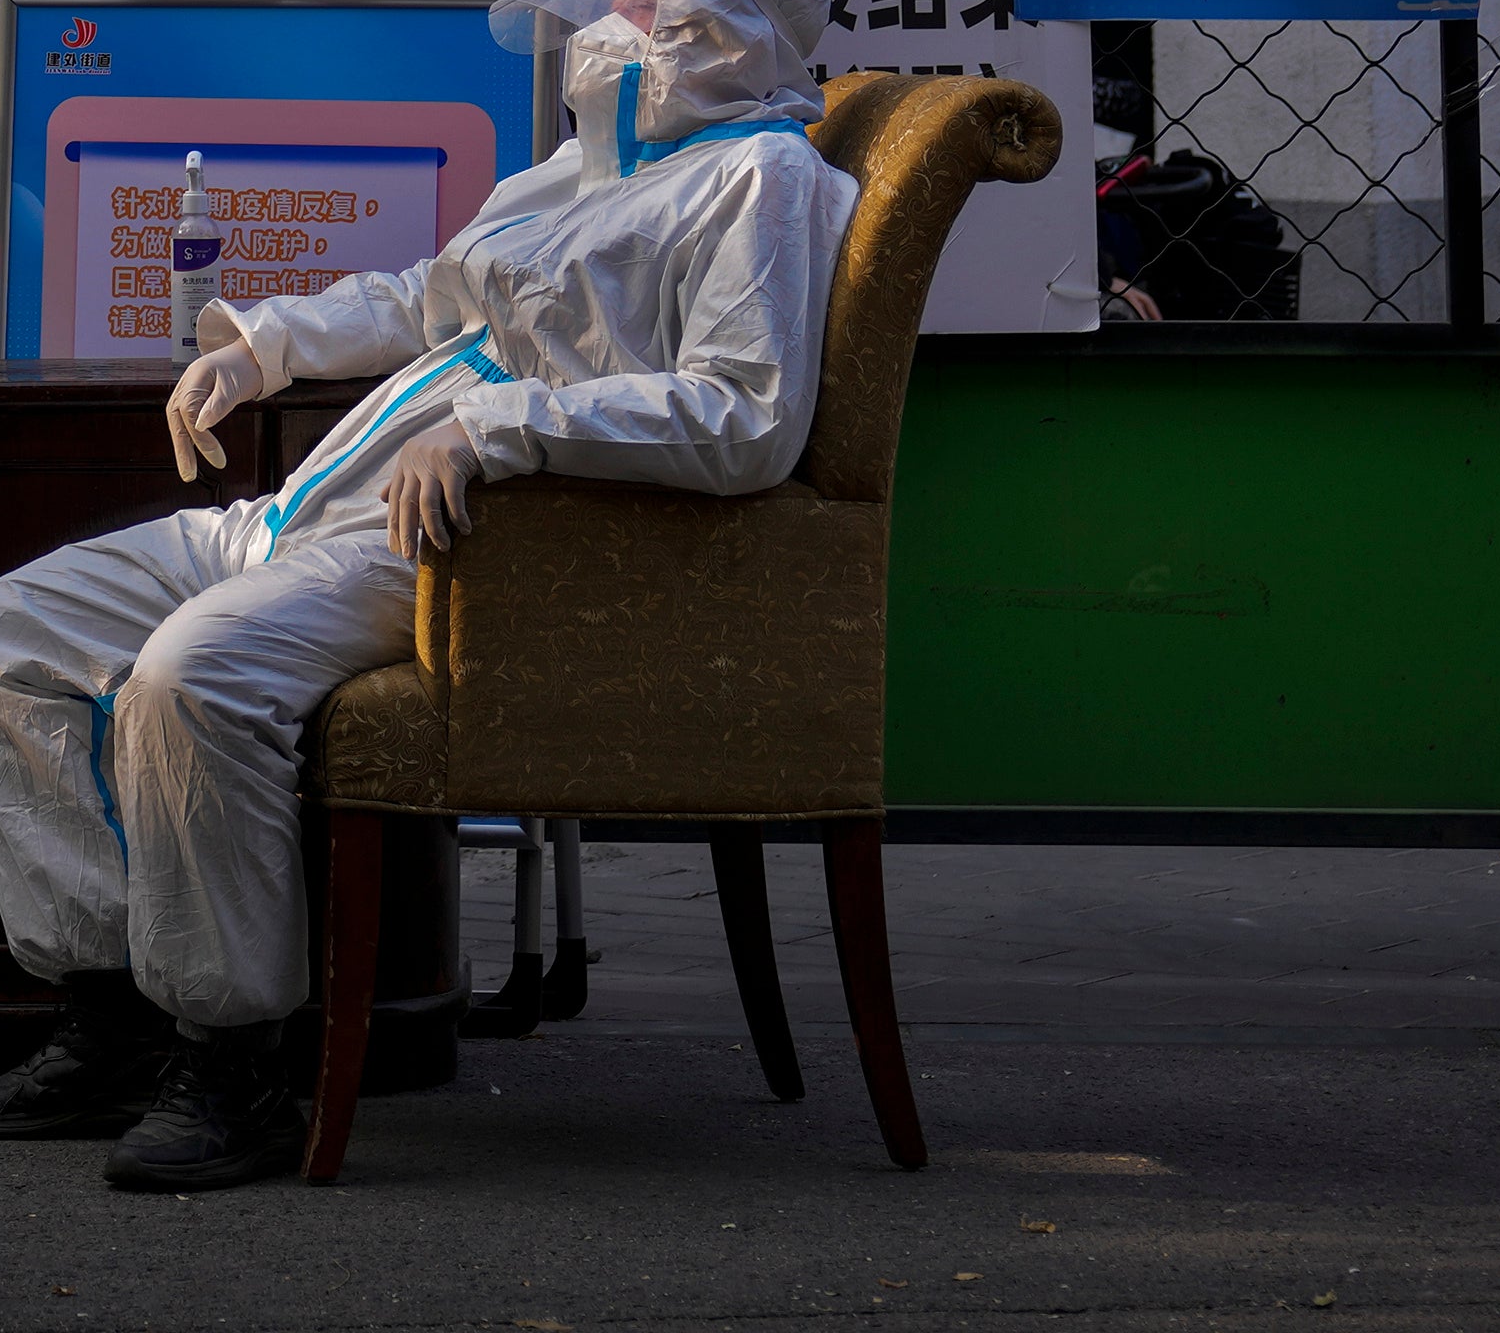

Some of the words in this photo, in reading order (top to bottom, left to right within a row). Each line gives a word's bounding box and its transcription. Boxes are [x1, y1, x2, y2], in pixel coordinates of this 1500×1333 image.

[46, 51, 112, 69] 建外街道
[110, 226, 328, 262] 为做人防护，
